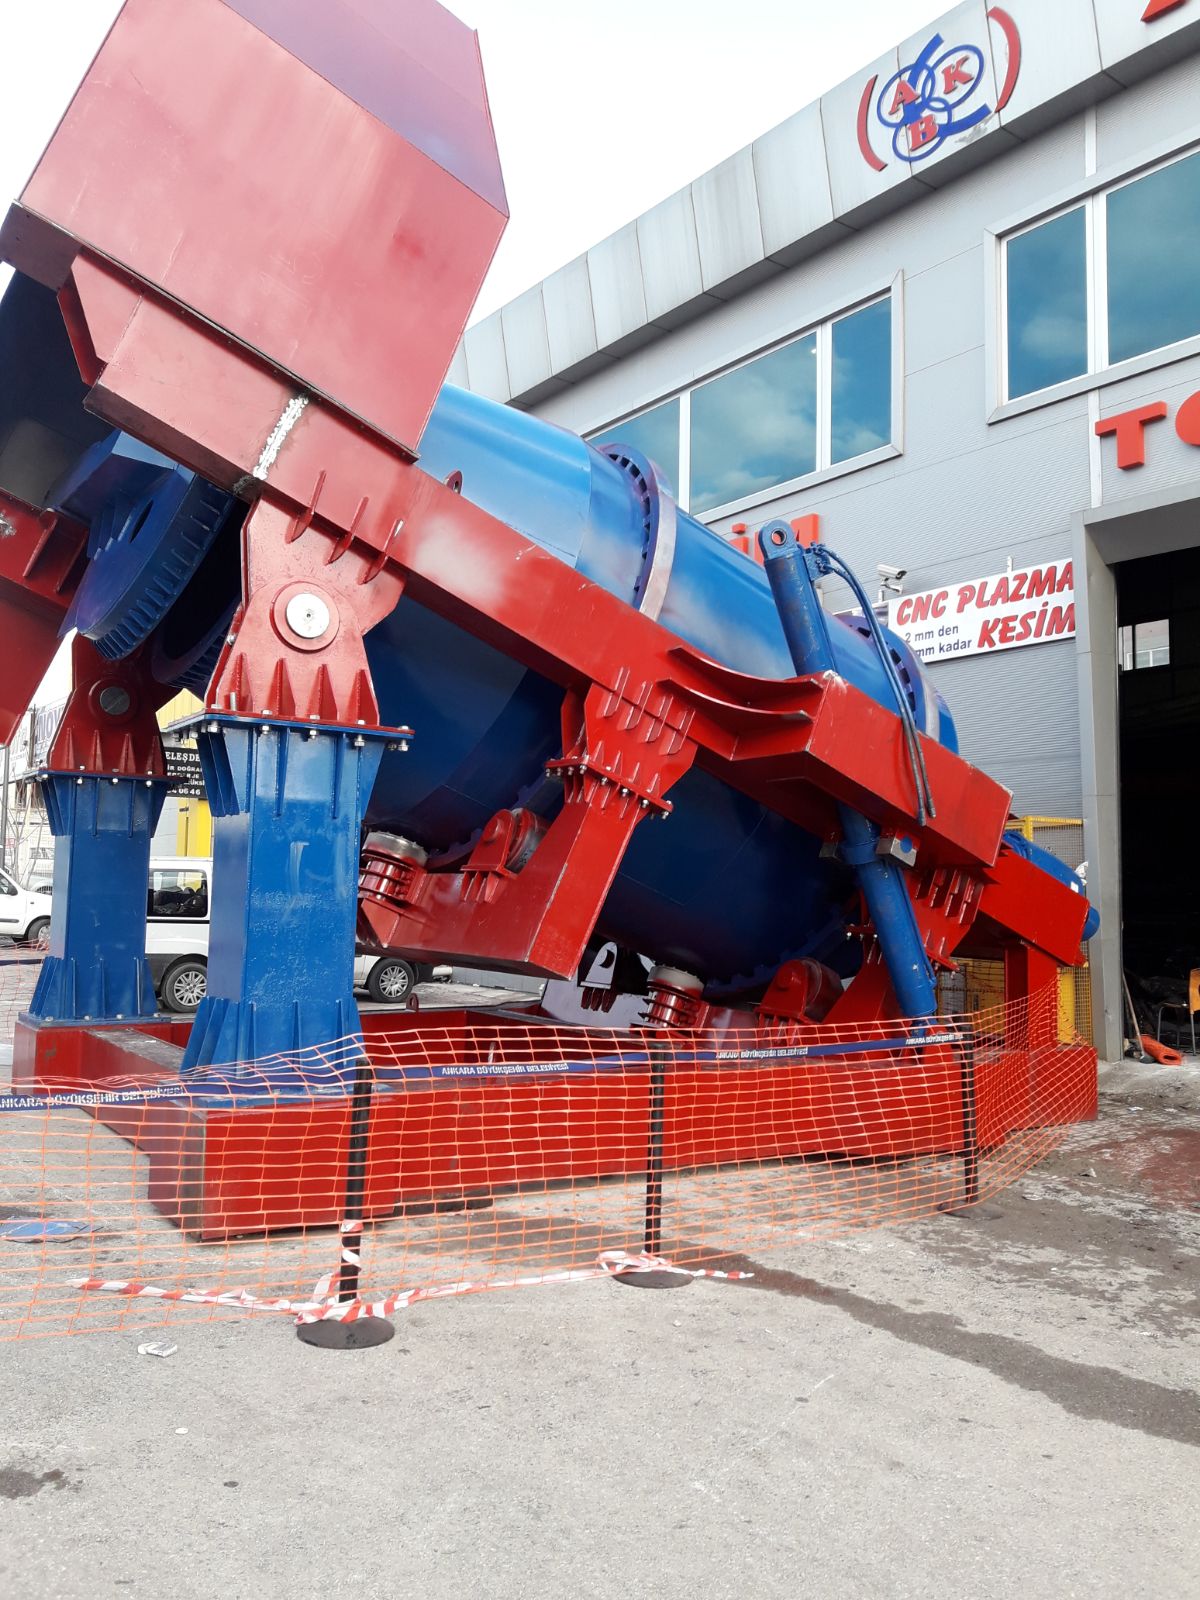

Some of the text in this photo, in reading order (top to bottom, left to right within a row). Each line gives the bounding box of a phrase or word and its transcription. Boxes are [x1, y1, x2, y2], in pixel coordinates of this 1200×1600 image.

[896, 561, 1074, 626] CNC PLAZMA
[914, 630, 934, 642] mm
[938, 625, 959, 637] den
[977, 601, 1076, 649] KESİM
[939, 639, 972, 654] kadar
[442, 1066, 476, 1076] ANKARA
